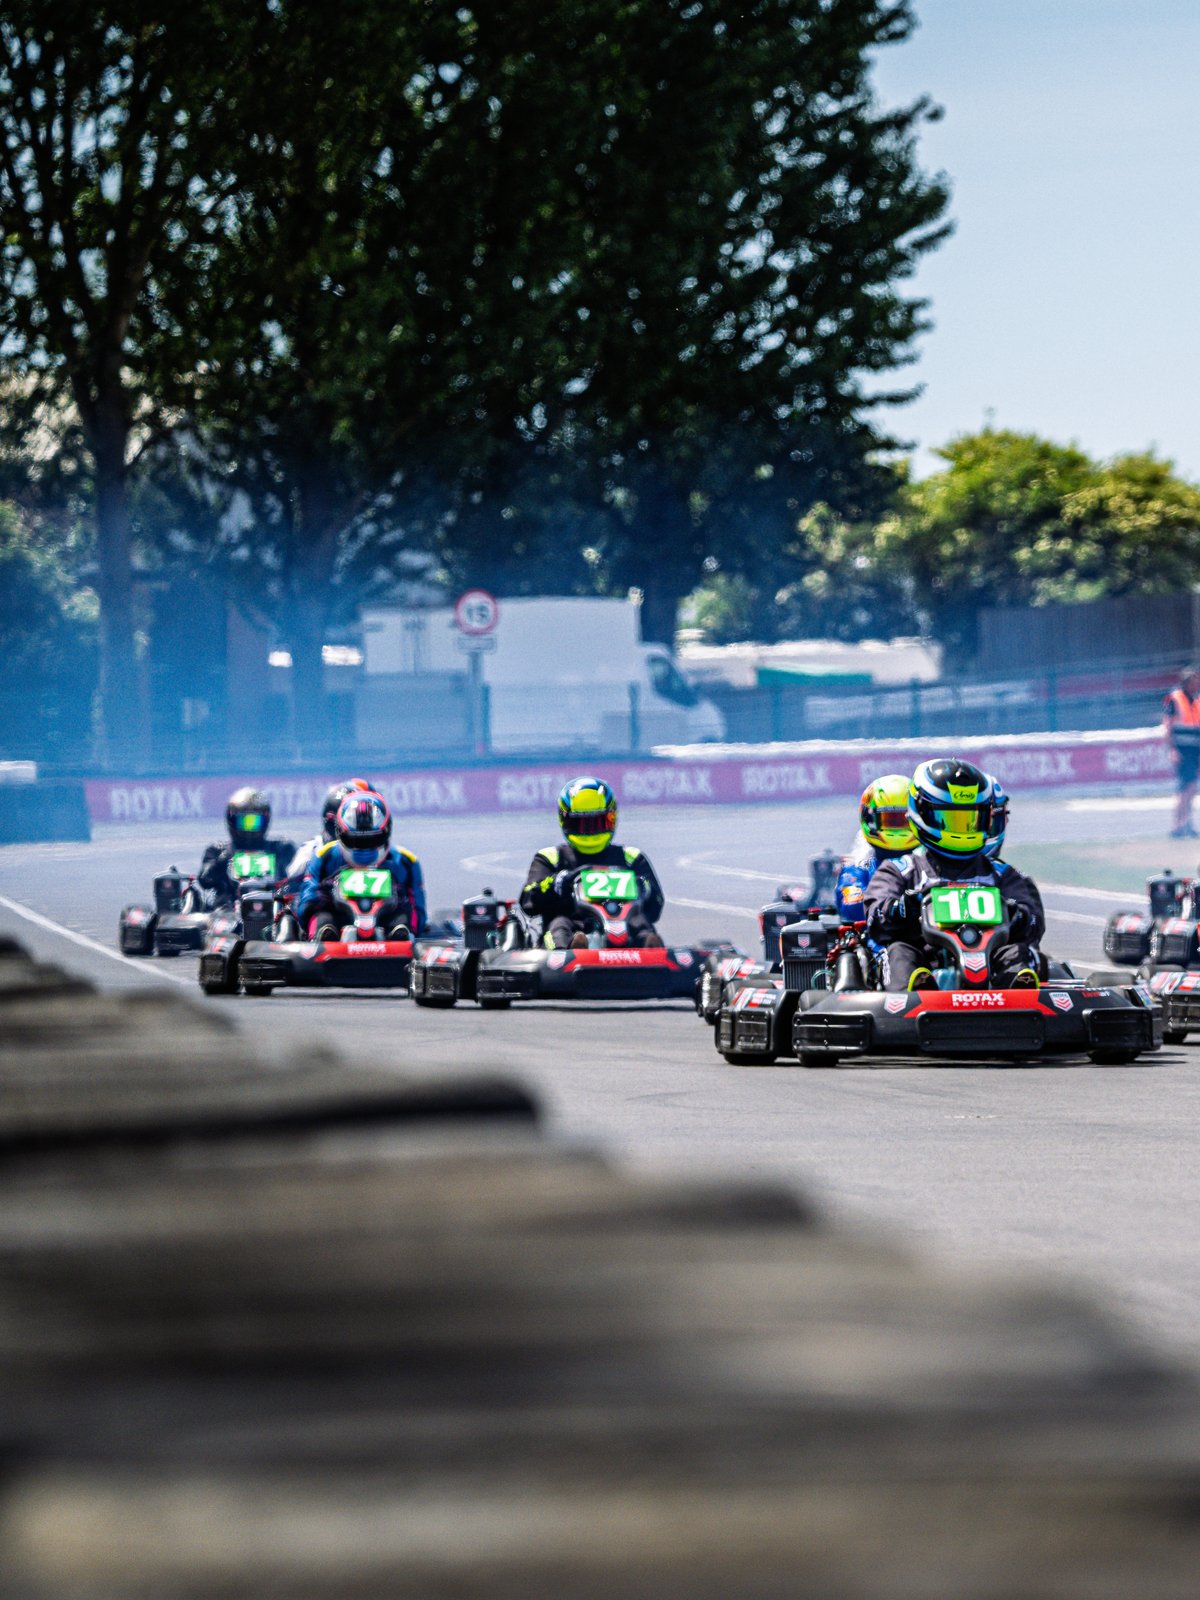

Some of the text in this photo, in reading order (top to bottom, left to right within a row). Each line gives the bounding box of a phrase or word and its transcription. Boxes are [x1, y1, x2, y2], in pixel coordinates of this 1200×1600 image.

[110, 784, 203, 820] ROTAX
[239, 854, 272, 875] 11
[343, 869, 389, 895] 47
[585, 871, 632, 898] 27
[937, 889, 997, 921] 10
[952, 993, 1004, 1002] ROTAX
